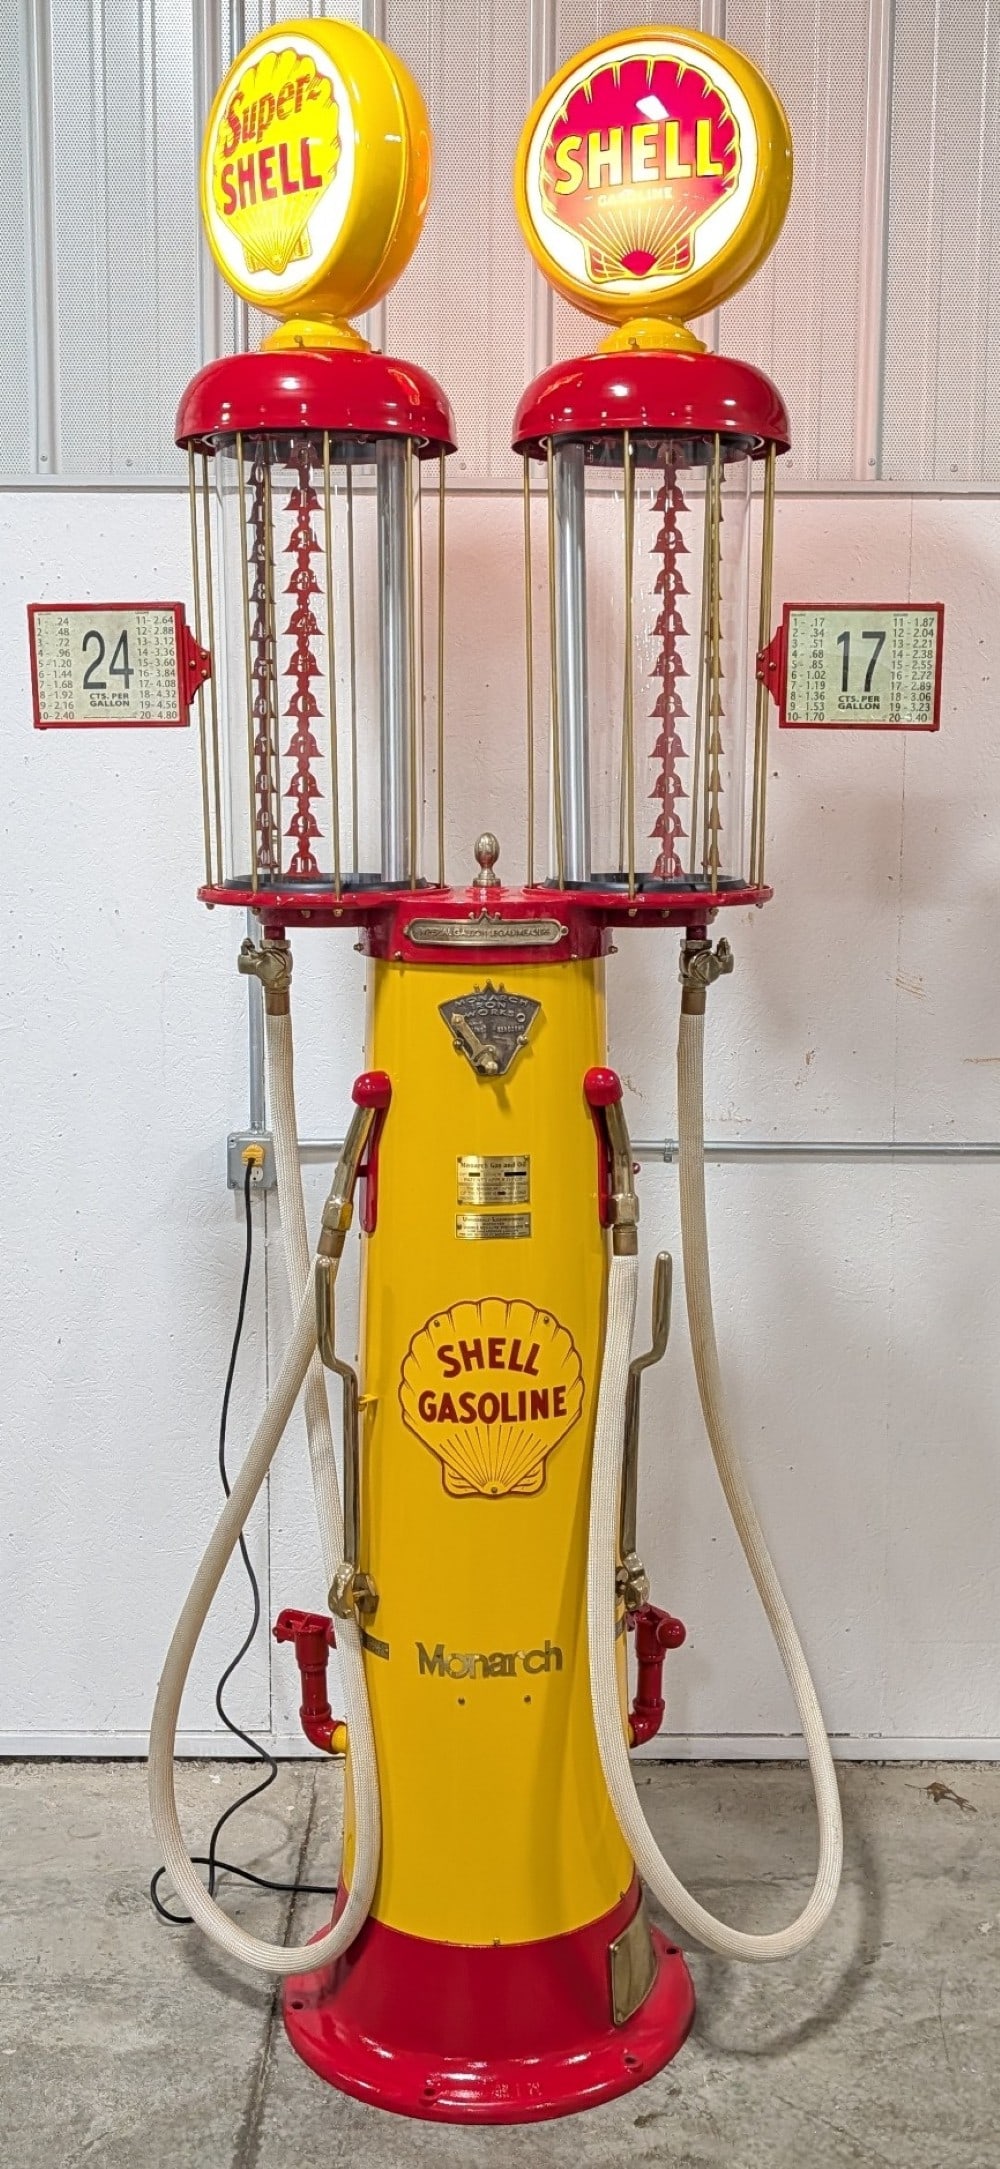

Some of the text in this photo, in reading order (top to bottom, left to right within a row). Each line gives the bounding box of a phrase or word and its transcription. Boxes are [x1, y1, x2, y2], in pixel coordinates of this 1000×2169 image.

[220, 136, 322, 215] SHELL
[554, 120, 724, 195] SHELL
[597, 186, 672, 208] GALINE
[82, 630, 134, 690] 24
[837, 631, 886, 692] 17
[296, 858, 312, 872] 10
[455, 994, 528, 1006] MONARCH
[465, 1008, 515, 1017] WORKS
[437, 1338, 540, 1378] SHELL
[418, 1386, 567, 1424] GASOLINE
[416, 1640, 562, 1679] Monarch
